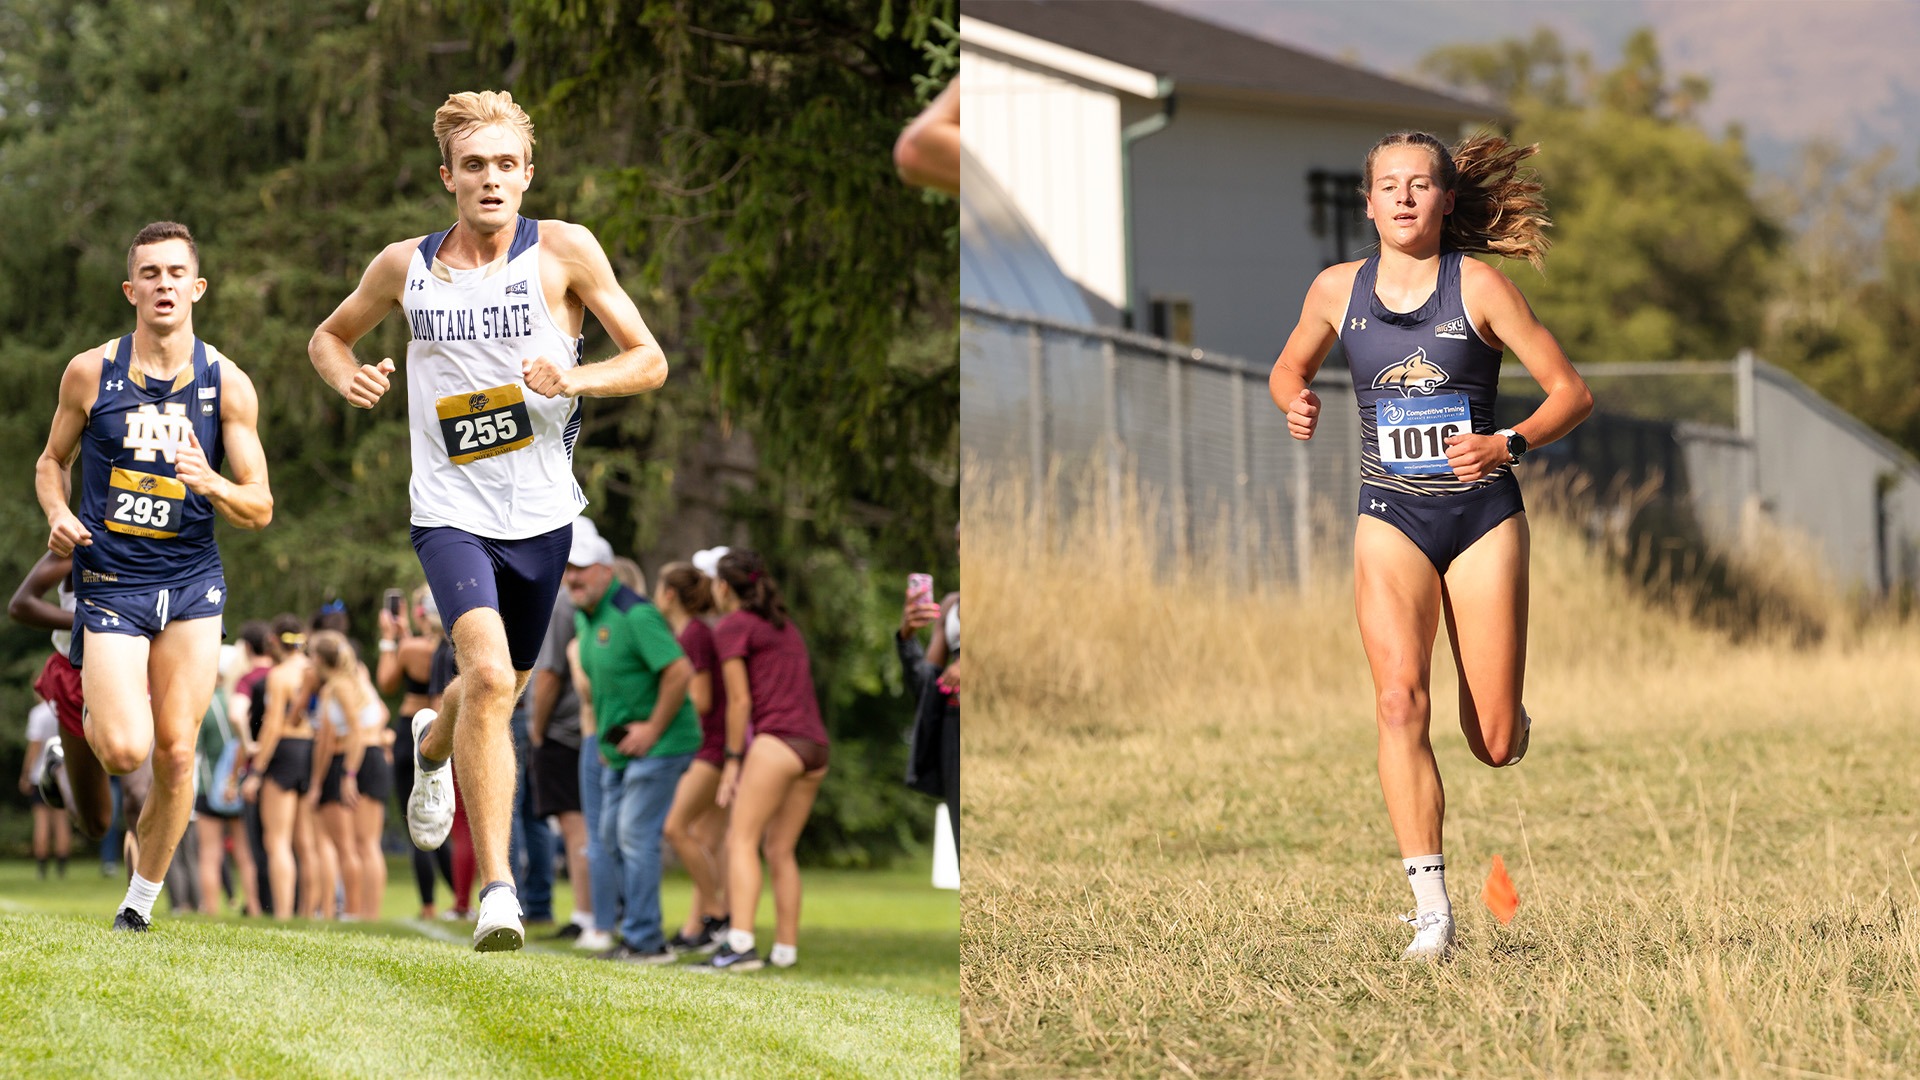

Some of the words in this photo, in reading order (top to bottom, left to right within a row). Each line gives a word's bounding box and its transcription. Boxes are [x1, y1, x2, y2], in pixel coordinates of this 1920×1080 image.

[410, 309, 476, 341] MONTANA
[482, 304, 532, 339] STATE
[1406, 408, 1443, 417] Competitive
[1443, 406, 1465, 414] Timing
[455, 410, 518, 450] 255
[113, 493, 171, 528] 293
